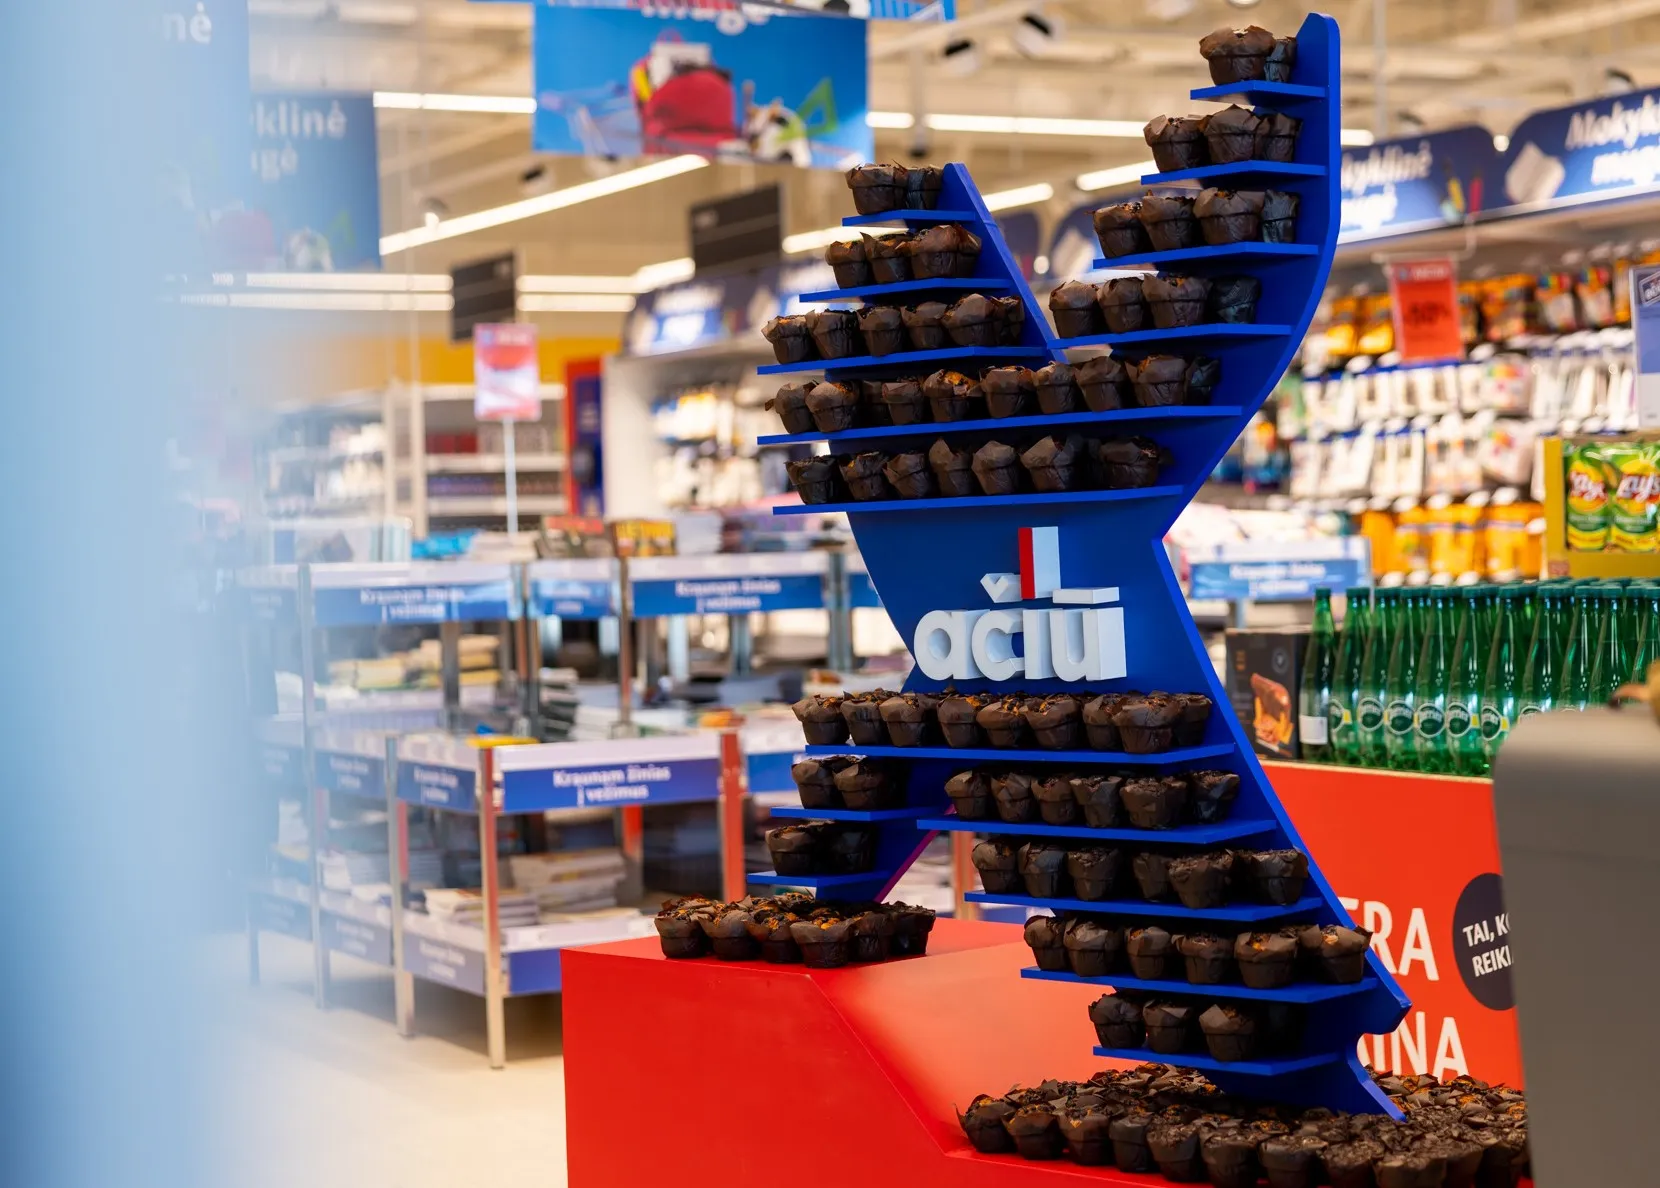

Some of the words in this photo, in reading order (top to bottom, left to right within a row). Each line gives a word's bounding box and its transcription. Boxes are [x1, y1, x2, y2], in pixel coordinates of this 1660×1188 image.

[914, 526, 1127, 682] ačiū
[553, 768, 625, 788] Kraunam
[626, 763, 671, 783] žinias
[585, 782, 649, 802] vežimus
[1462, 919, 1495, 947] TAI,
[1471, 944, 1514, 977] REIKI
